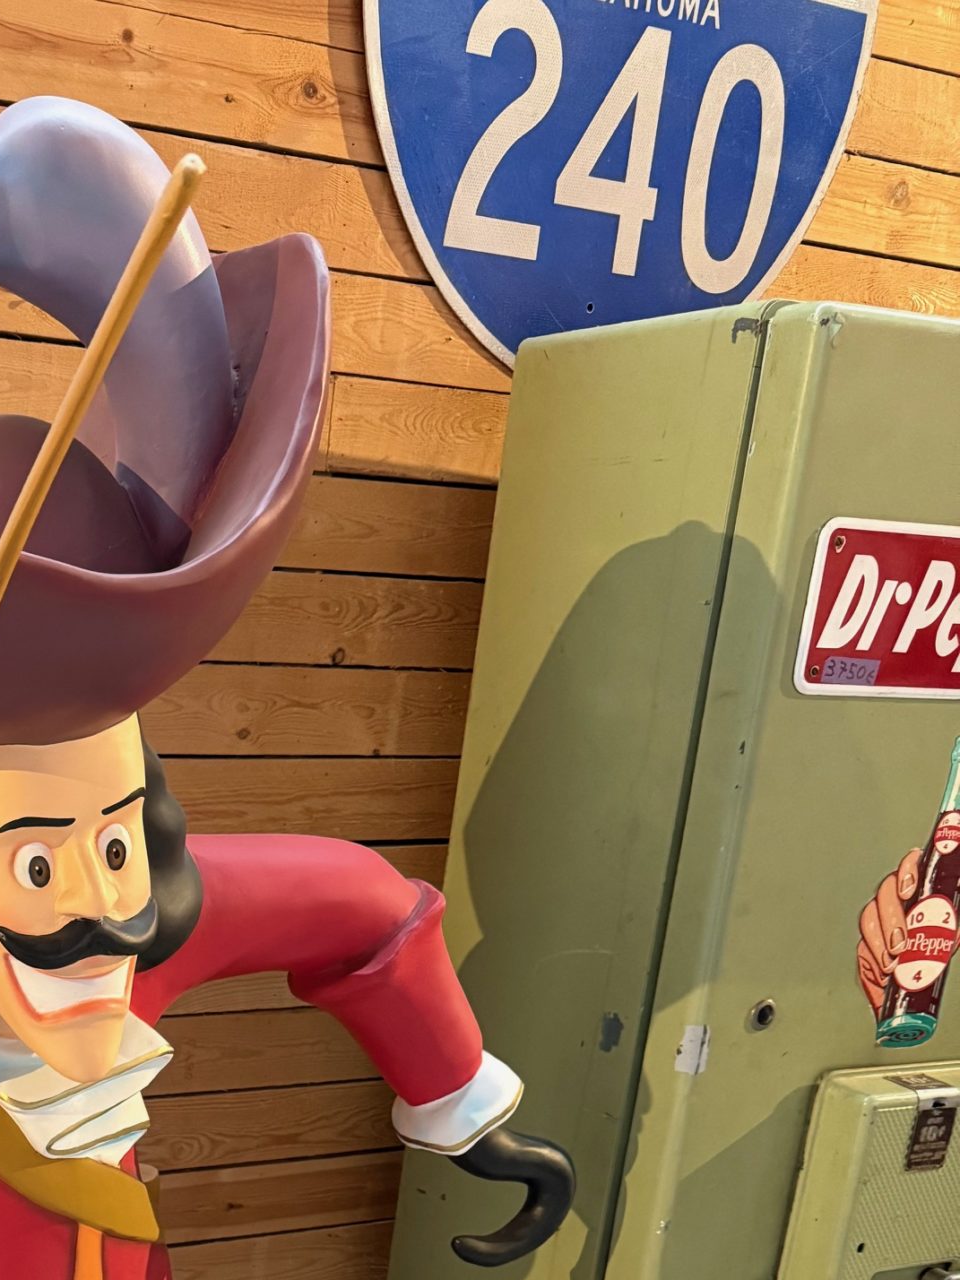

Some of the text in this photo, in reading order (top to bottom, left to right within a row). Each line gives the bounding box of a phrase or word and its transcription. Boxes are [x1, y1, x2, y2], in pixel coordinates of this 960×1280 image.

[443, 0, 785, 294] 240
[910, 911, 951, 926] 10 2
[913, 969, 922, 983] 4
